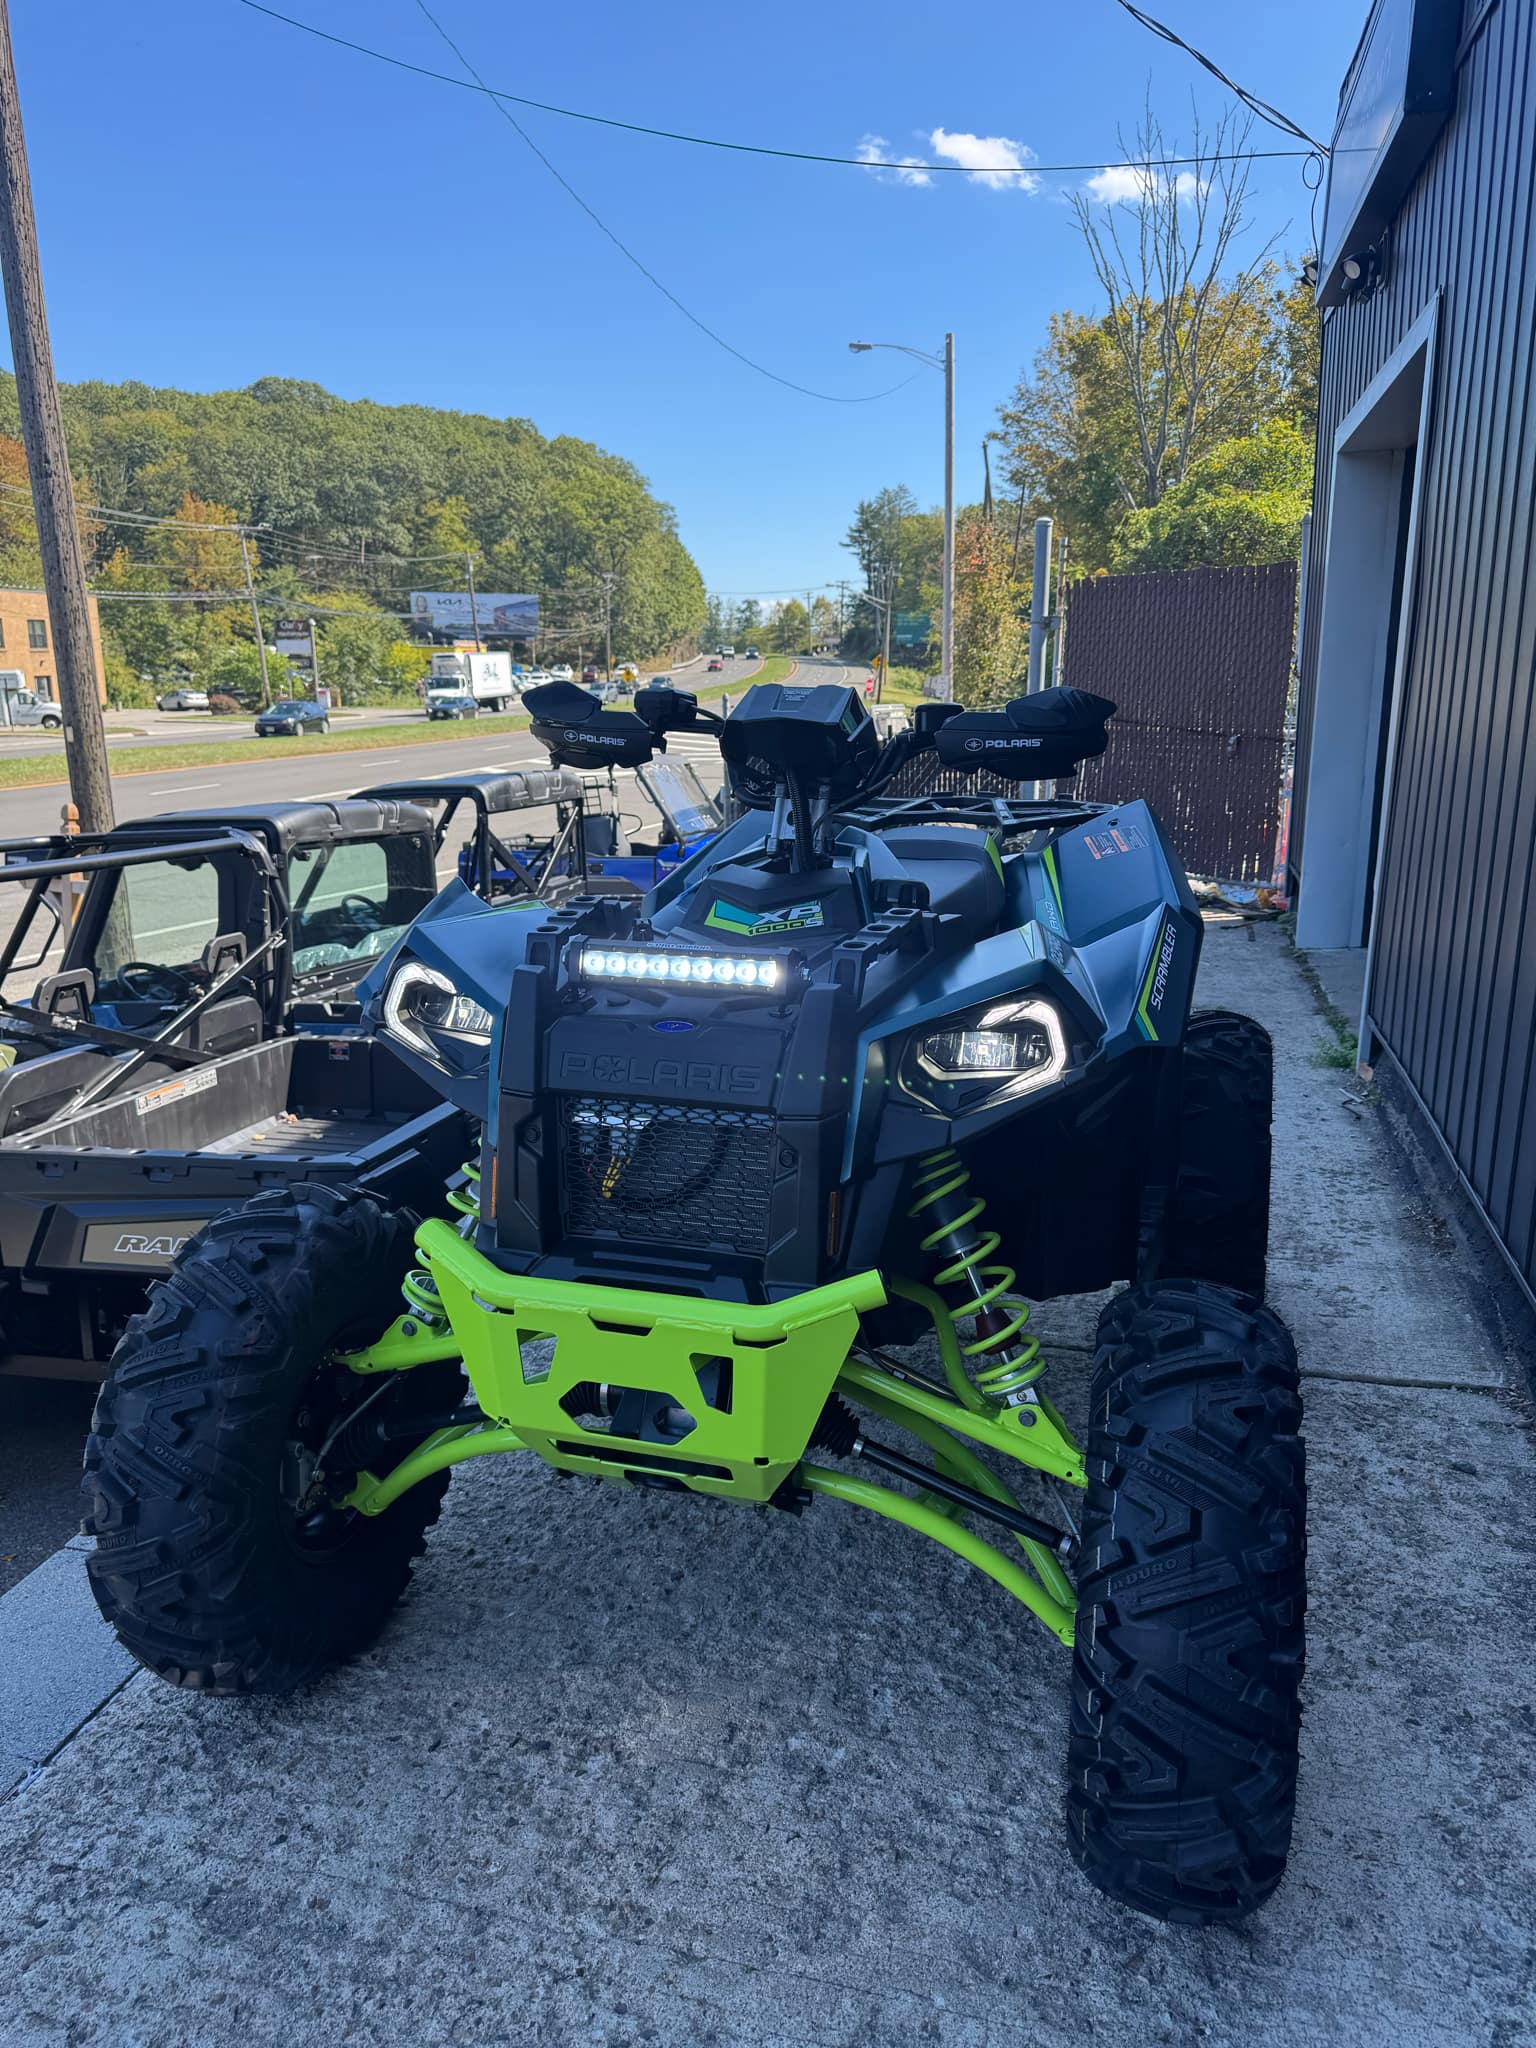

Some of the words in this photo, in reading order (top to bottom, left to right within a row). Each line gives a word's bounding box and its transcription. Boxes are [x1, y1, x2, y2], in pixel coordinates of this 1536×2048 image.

[579, 733, 625, 746] POLARIS
[985, 739, 1041, 748] POLARIS
[752, 905, 821, 926] XP
[1151, 923, 1177, 1011] SCRAMBLER
[560, 1051, 761, 1093] POLARIS
[1125, 1557, 1178, 1584] DURO
